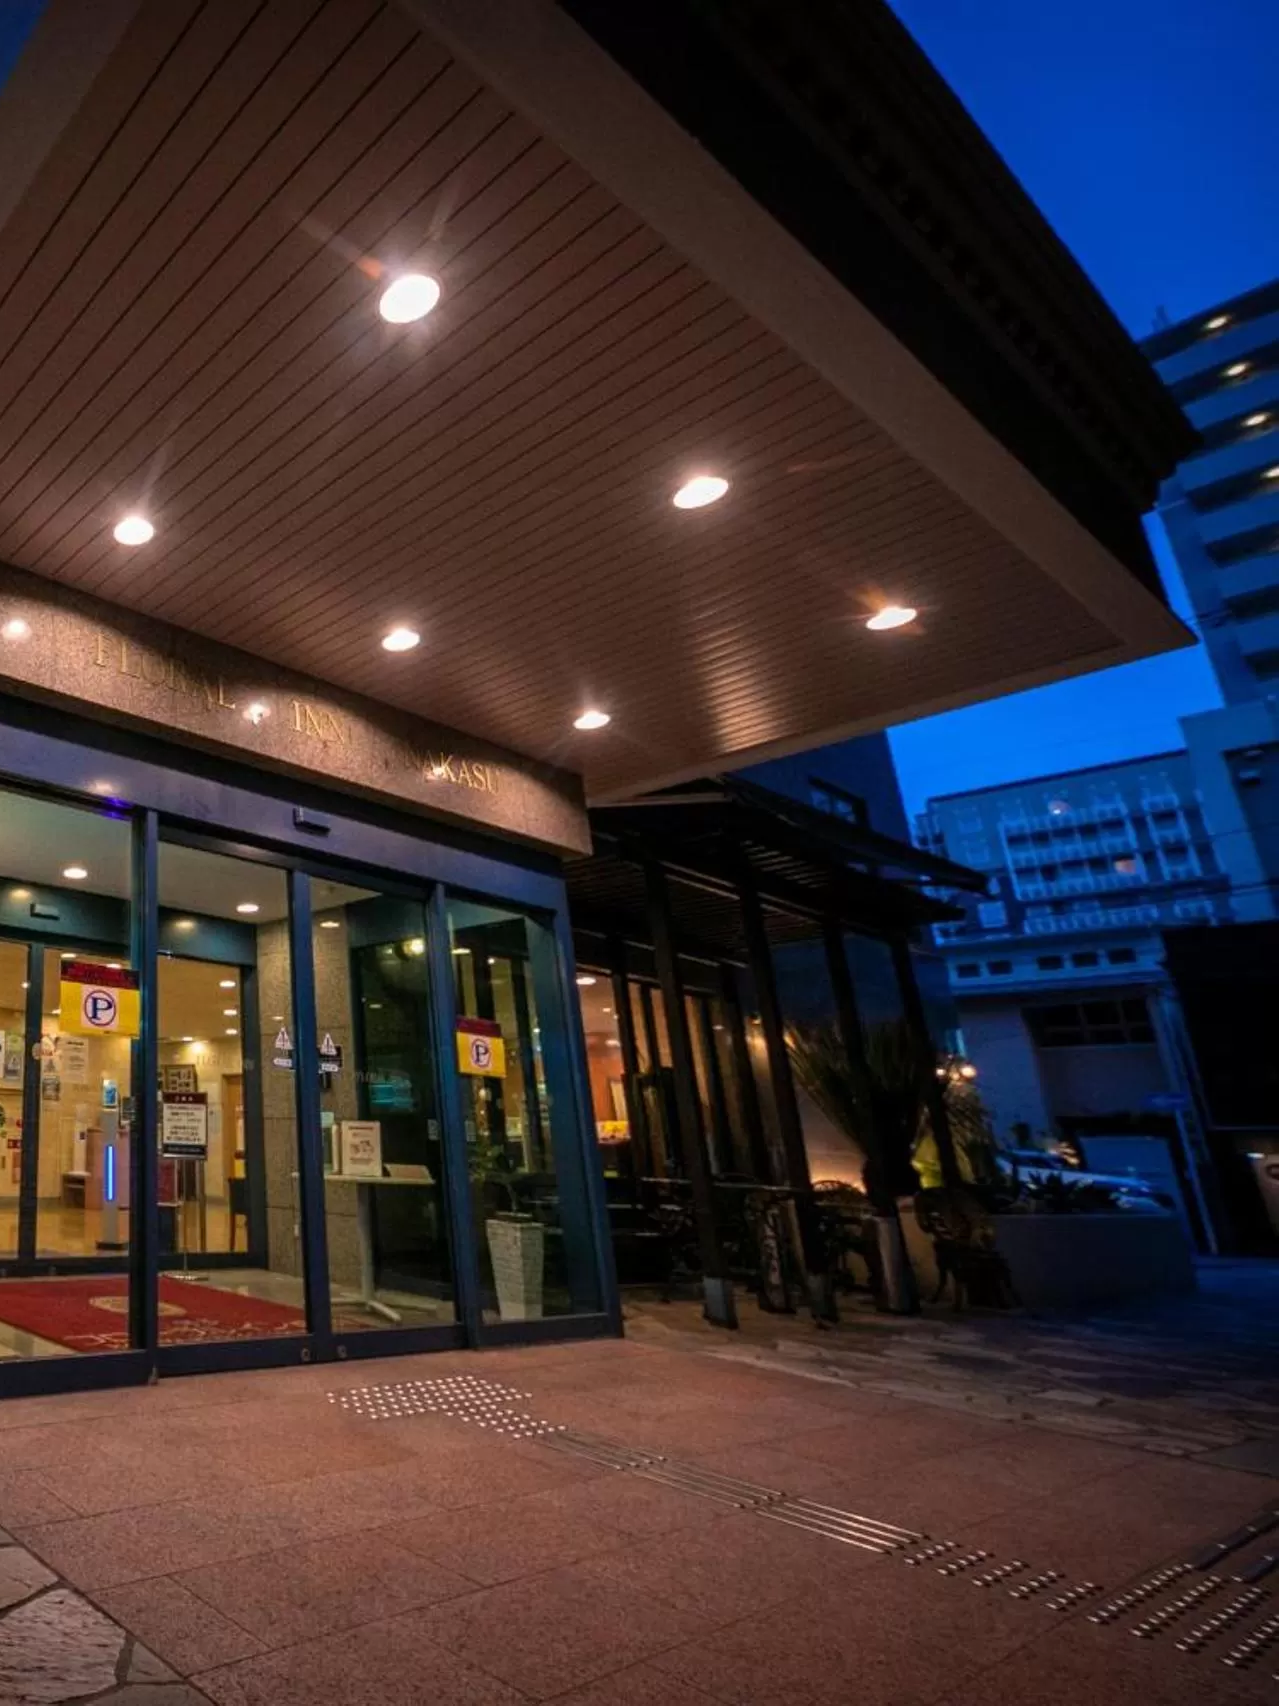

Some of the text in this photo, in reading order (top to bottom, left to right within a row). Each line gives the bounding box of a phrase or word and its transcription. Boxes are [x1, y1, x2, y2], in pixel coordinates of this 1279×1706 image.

[290, 699, 352, 745] INN
[91, 996, 114, 1021] P
[475, 1043, 490, 1064] P
